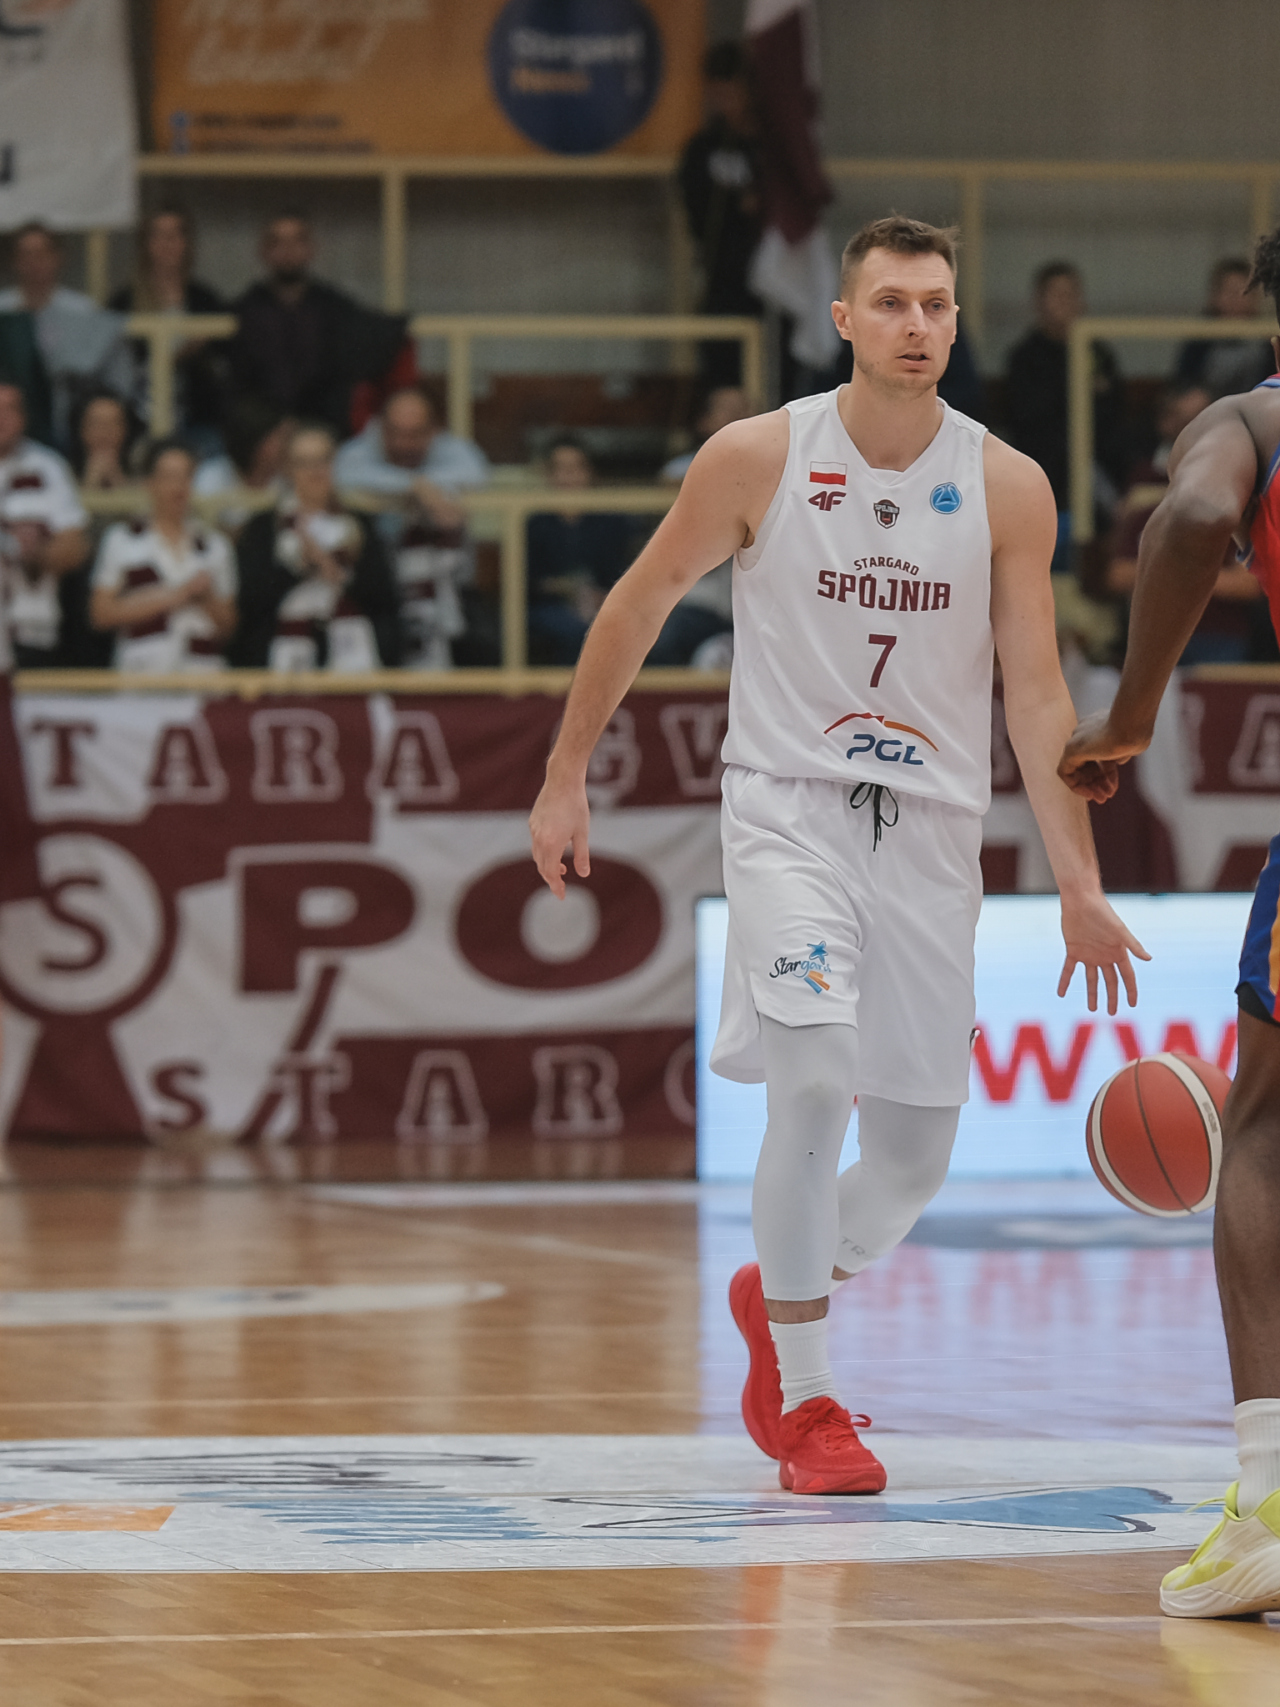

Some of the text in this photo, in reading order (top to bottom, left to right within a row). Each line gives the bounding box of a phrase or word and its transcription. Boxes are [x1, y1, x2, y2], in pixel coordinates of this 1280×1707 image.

[854, 556, 920, 576] STARGARD
[817, 569, 951, 612] SPÓJNIA
[868, 633, 897, 688] 7
[846, 733, 924, 765] PGL
